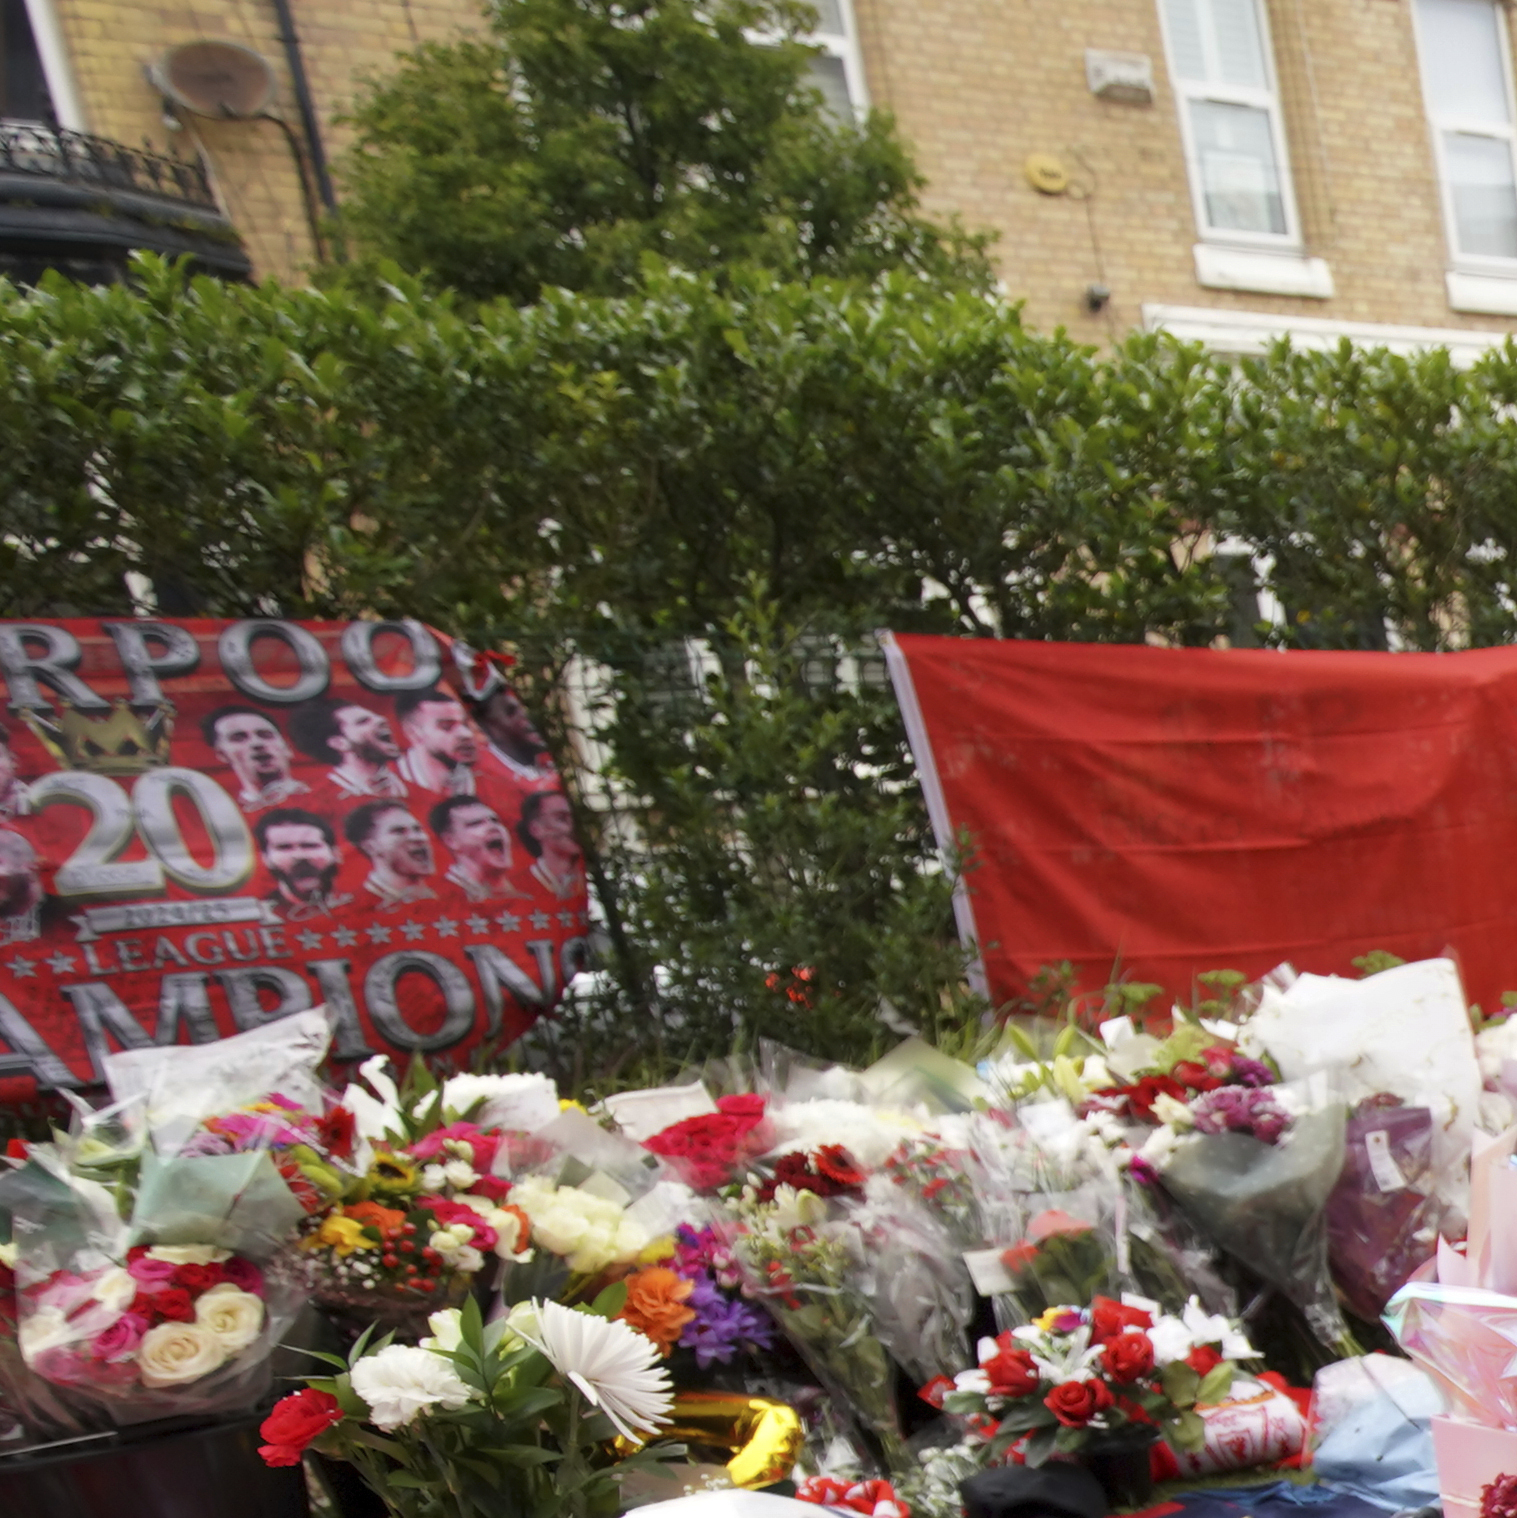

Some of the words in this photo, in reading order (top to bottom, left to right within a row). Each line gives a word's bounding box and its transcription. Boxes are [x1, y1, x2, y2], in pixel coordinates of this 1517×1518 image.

[0, 618, 505, 711] RPOO
[27, 767, 255, 895] 20
[81, 926, 294, 977] LEAGUE
